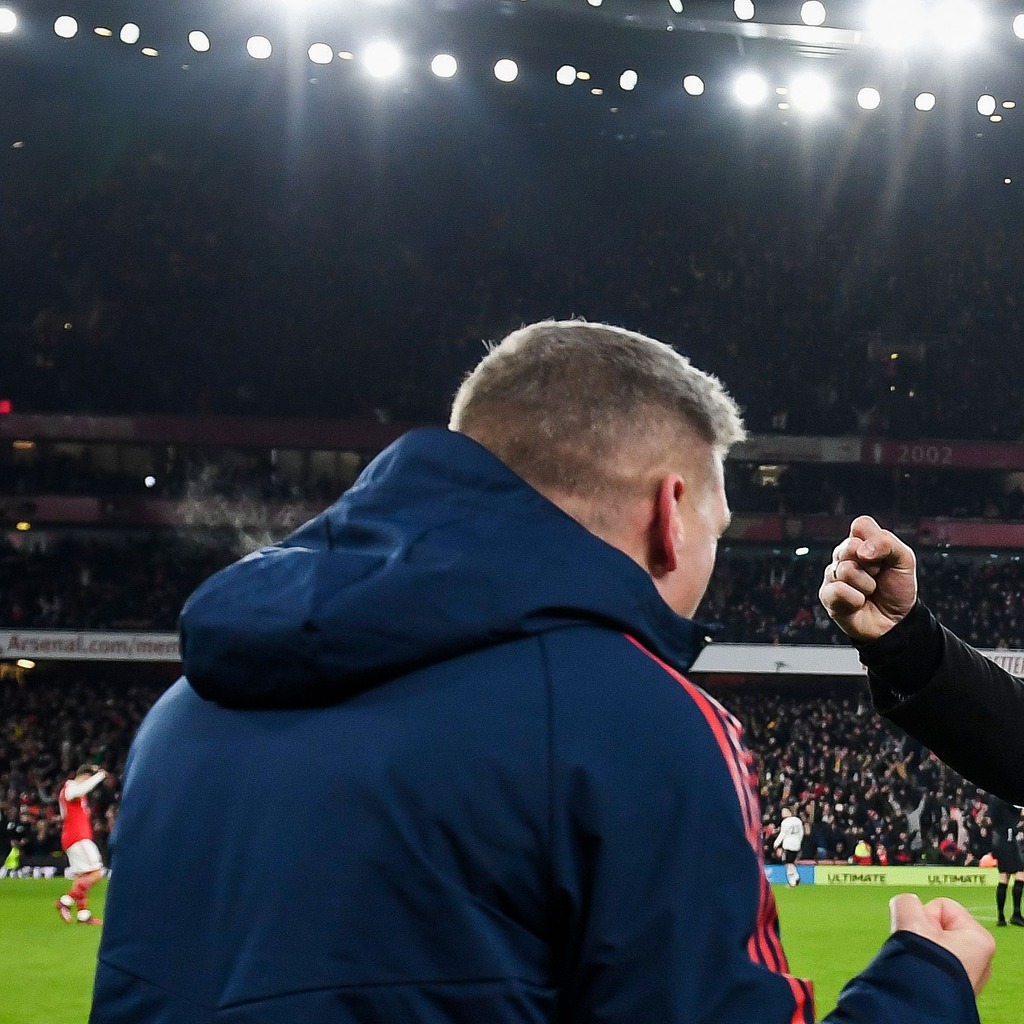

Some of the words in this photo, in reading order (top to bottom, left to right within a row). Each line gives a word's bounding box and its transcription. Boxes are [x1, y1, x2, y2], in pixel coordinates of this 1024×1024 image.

[897, 444, 953, 465] 2002
[828, 873, 887, 883] ULTIMATE
[928, 874, 987, 884] ULTIMATE
